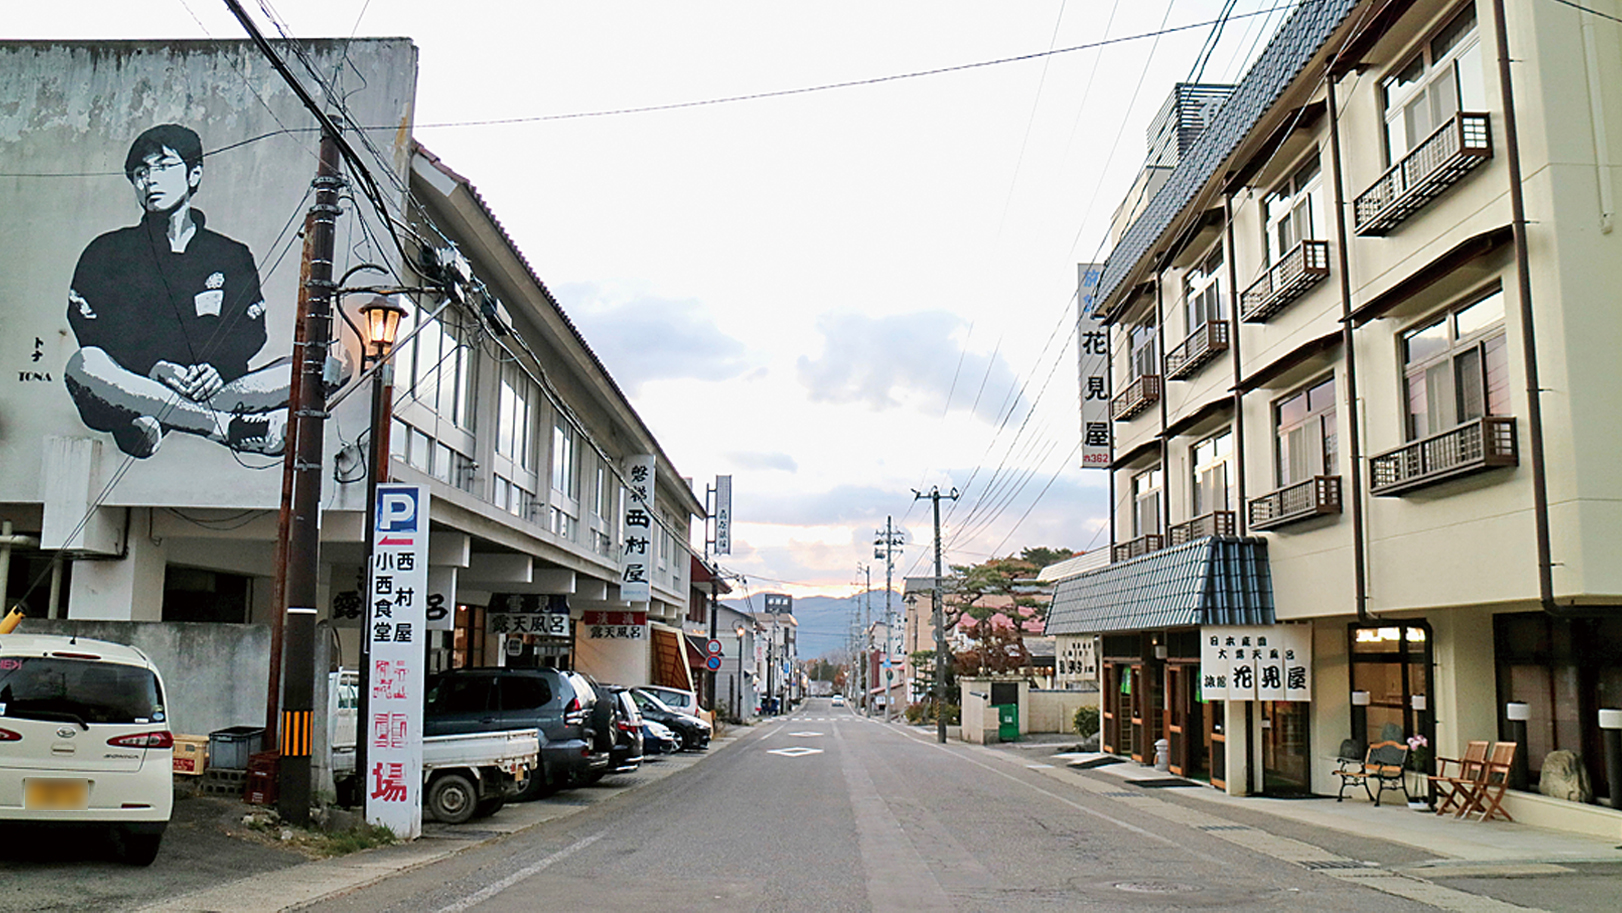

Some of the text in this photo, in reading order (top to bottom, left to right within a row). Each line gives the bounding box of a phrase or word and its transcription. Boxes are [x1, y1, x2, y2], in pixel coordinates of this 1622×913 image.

[31, 337, 44, 362] トナ
[18, 371, 52, 381] TONA
[1083, 331, 1109, 447] 花見屋
[1091, 454, 1109, 463] 362
[381, 493, 414, 529] P
[374, 552, 394, 642] 小西食堂
[393, 553, 415, 643] 西村屋
[491, 614, 565, 633] 露天風呂
[590, 626, 641, 638] 露天風呂
[1209, 635, 1267, 646] 日本庭園
[1218, 649, 1294, 660] 大露天風呂
[1233, 665, 1307, 689] 花見屋
[371, 660, 408, 802] 駐車場
